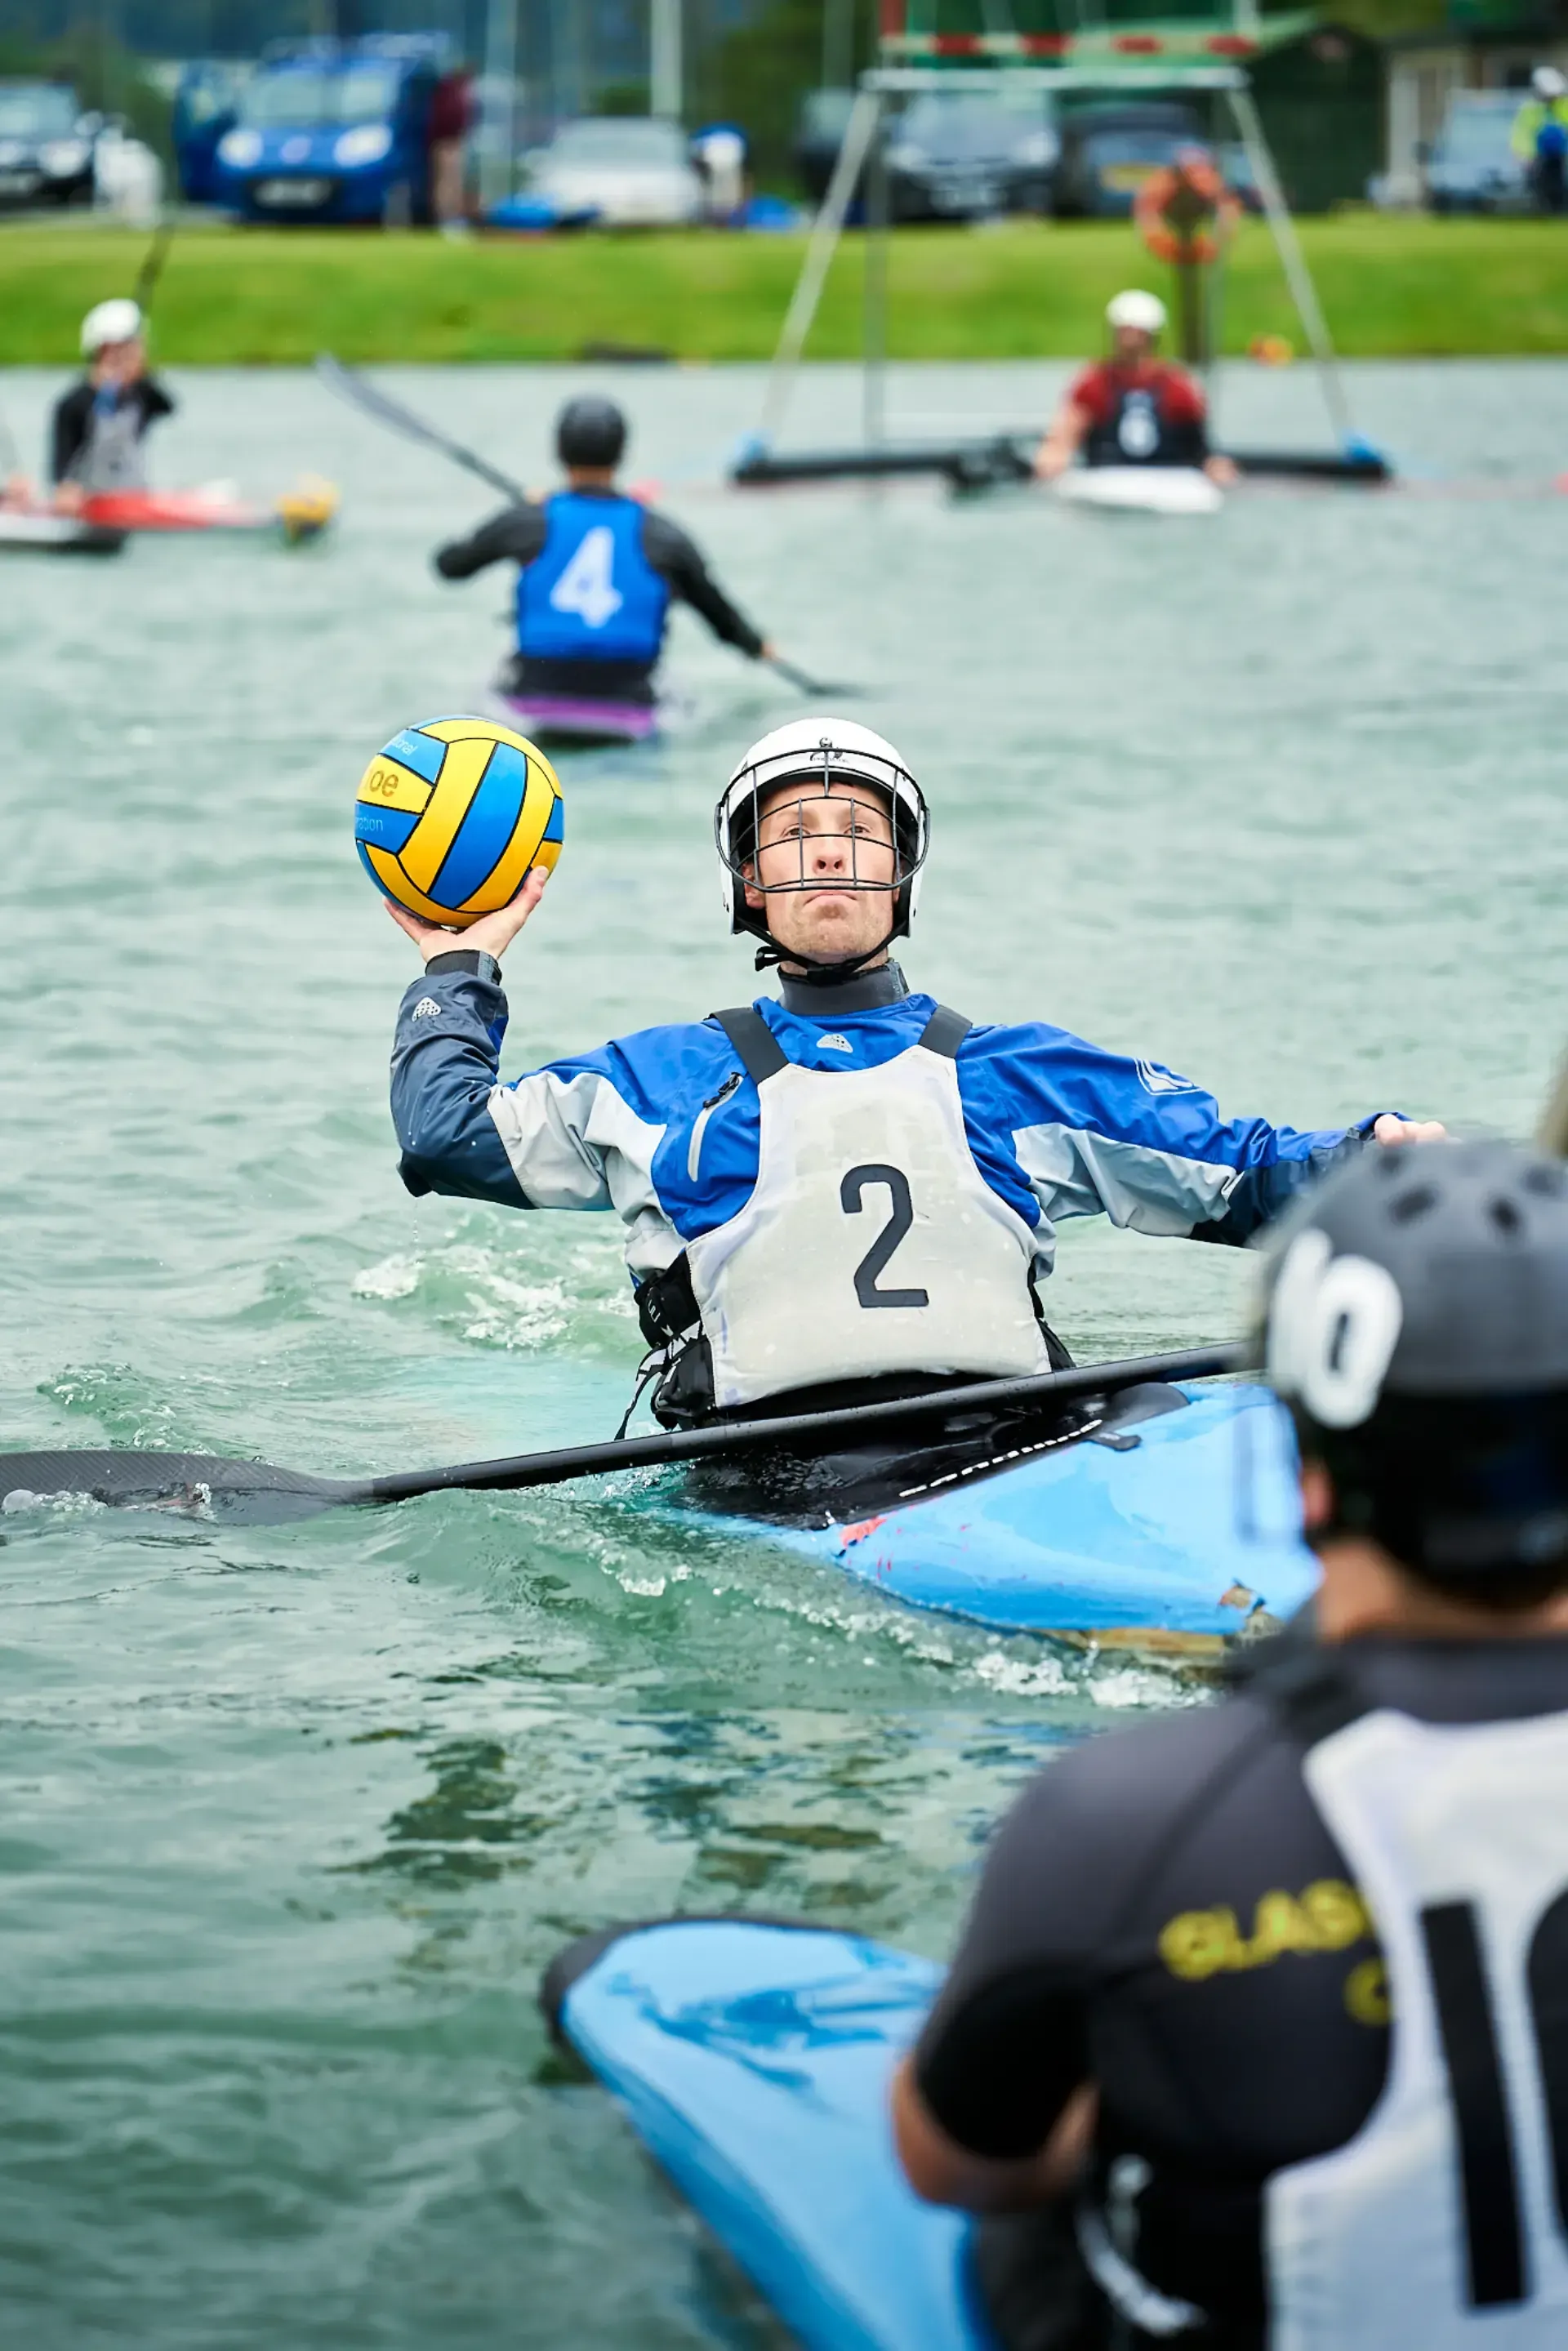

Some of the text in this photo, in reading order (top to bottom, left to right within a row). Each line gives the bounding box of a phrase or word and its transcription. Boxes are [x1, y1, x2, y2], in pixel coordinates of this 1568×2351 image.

[550, 527, 623, 628] 4
[840, 1164, 929, 1307] 2
[1158, 1878, 1372, 1983] GLAS
